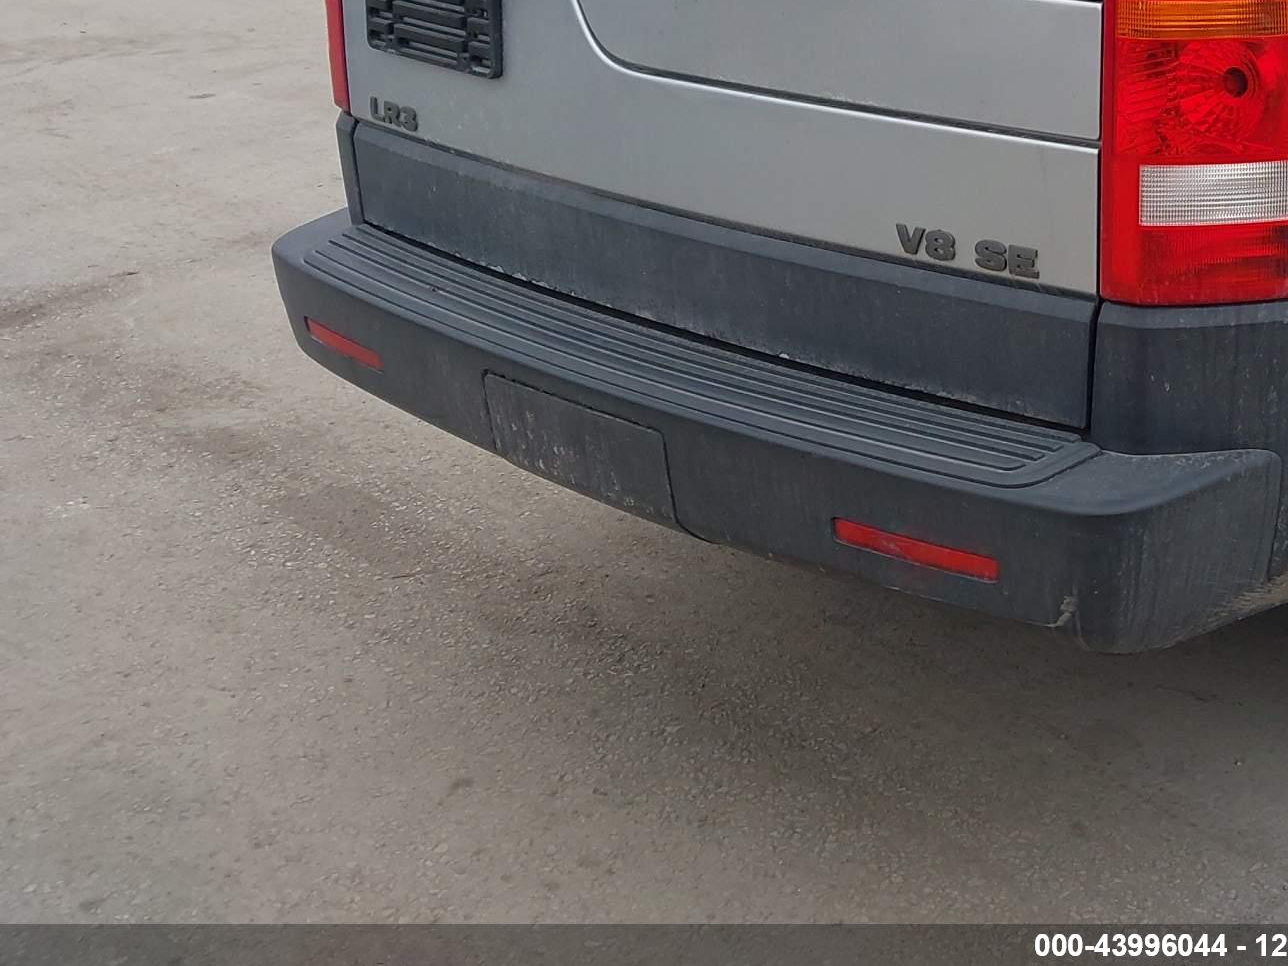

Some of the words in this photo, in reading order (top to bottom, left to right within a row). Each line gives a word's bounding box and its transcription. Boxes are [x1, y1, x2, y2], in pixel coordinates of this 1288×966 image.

[370, 96, 416, 130] LR3
[895, 223, 956, 262] V8
[975, 239, 1040, 279] SE
